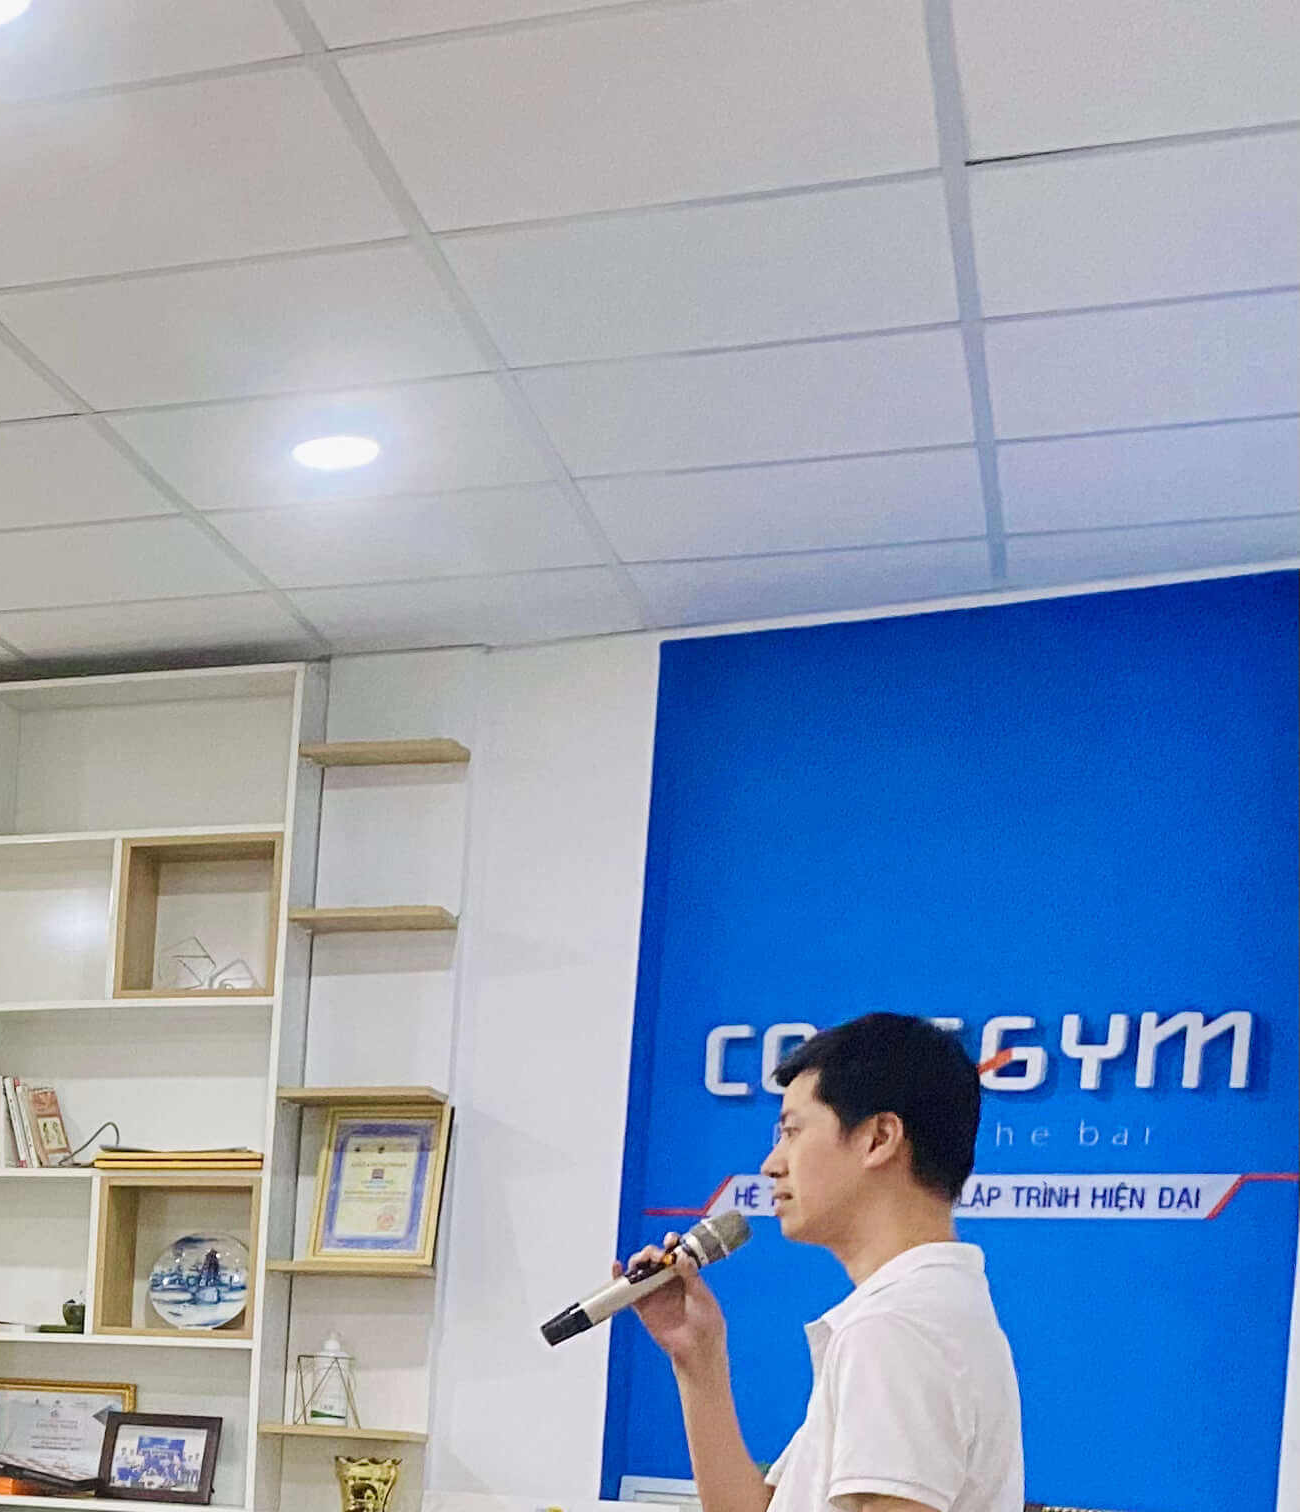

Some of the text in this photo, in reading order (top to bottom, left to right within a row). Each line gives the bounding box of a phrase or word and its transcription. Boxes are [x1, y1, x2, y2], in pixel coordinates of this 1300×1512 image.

[704, 1010, 1255, 1098] COGYM
[995, 1119, 1153, 1147] he bar
[1013, 1181, 1080, 1209] TRÌNH
[1090, 1182, 1146, 1212] HIỆN
